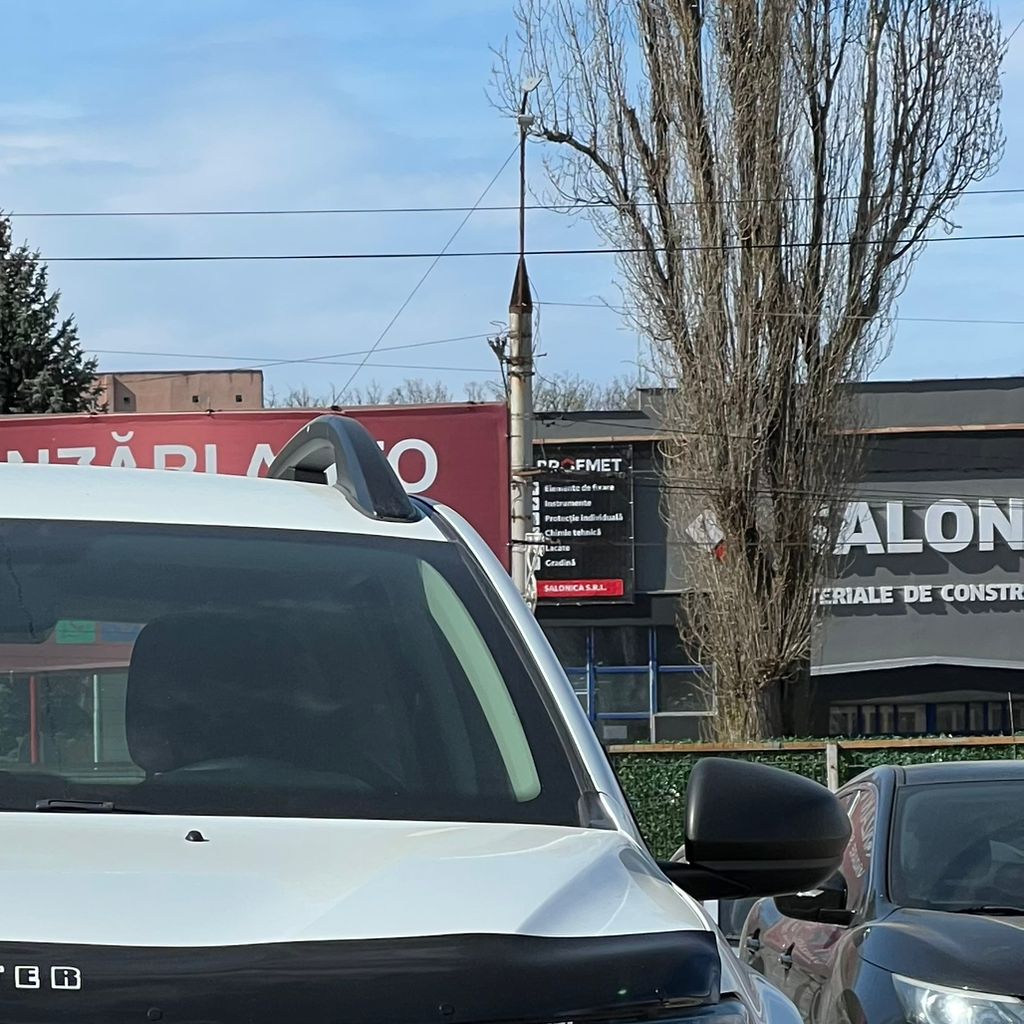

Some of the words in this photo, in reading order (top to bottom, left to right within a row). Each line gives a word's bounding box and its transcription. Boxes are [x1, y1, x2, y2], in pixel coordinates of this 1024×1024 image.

[544, 529, 572, 537] Chimie
[544, 584, 585, 592] SALONICA
[585, 583, 608, 591] S.R.L.
[904, 585, 932, 603] DE
[941, 583, 1024, 603] CONSTR
